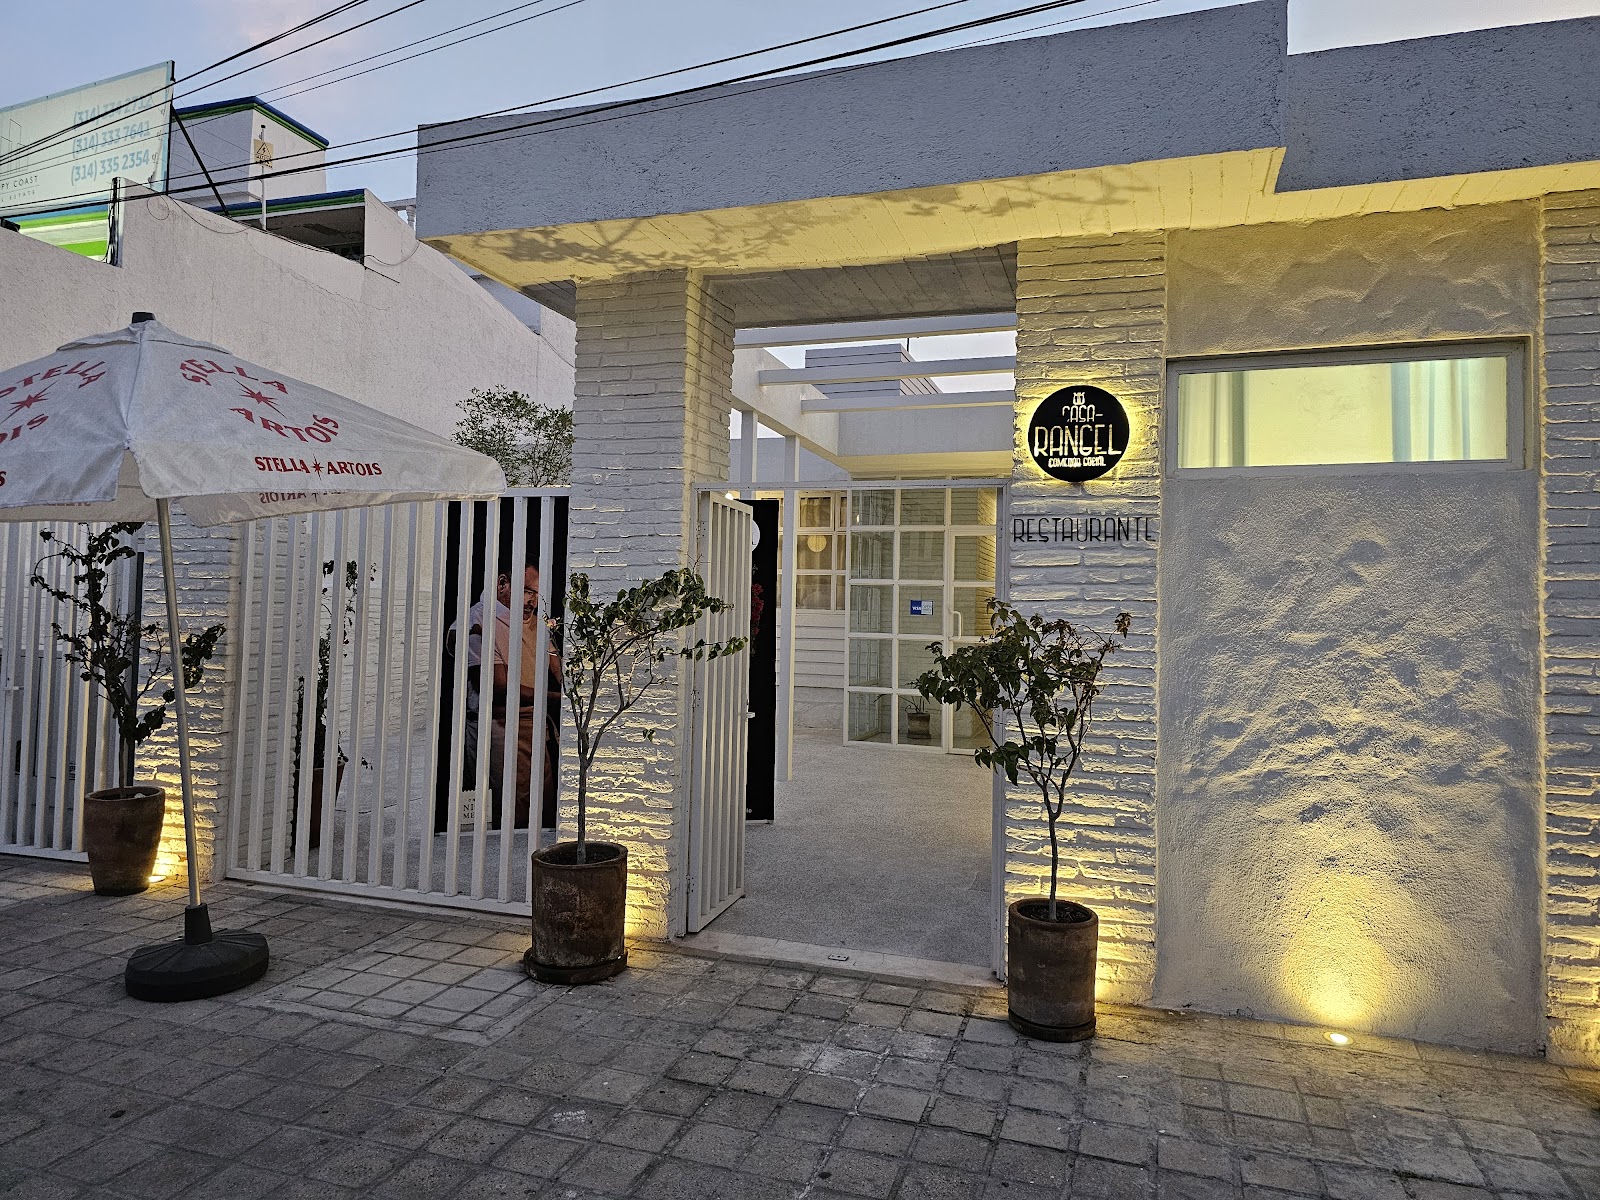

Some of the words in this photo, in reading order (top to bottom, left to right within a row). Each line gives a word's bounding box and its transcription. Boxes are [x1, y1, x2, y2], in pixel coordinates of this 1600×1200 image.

[73, 132, 99, 159] (314)
[101, 127, 121, 148] 333
[13, 175, 39, 188] COAST
[71, 160, 98, 186] (314)
[100, 156, 120, 176] 335
[121, 149, 150, 171] 2354
[180, 358, 289, 395] STELLA
[228, 407, 339, 443] ARTOIS
[1062, 404, 1096, 423] CASA
[1033, 423, 1122, 457] RANGEL
[254, 456, 310, 474] STELLA
[326, 461, 383, 476] ARTOIS
[1013, 516, 1156, 543] RESTAURANTE
